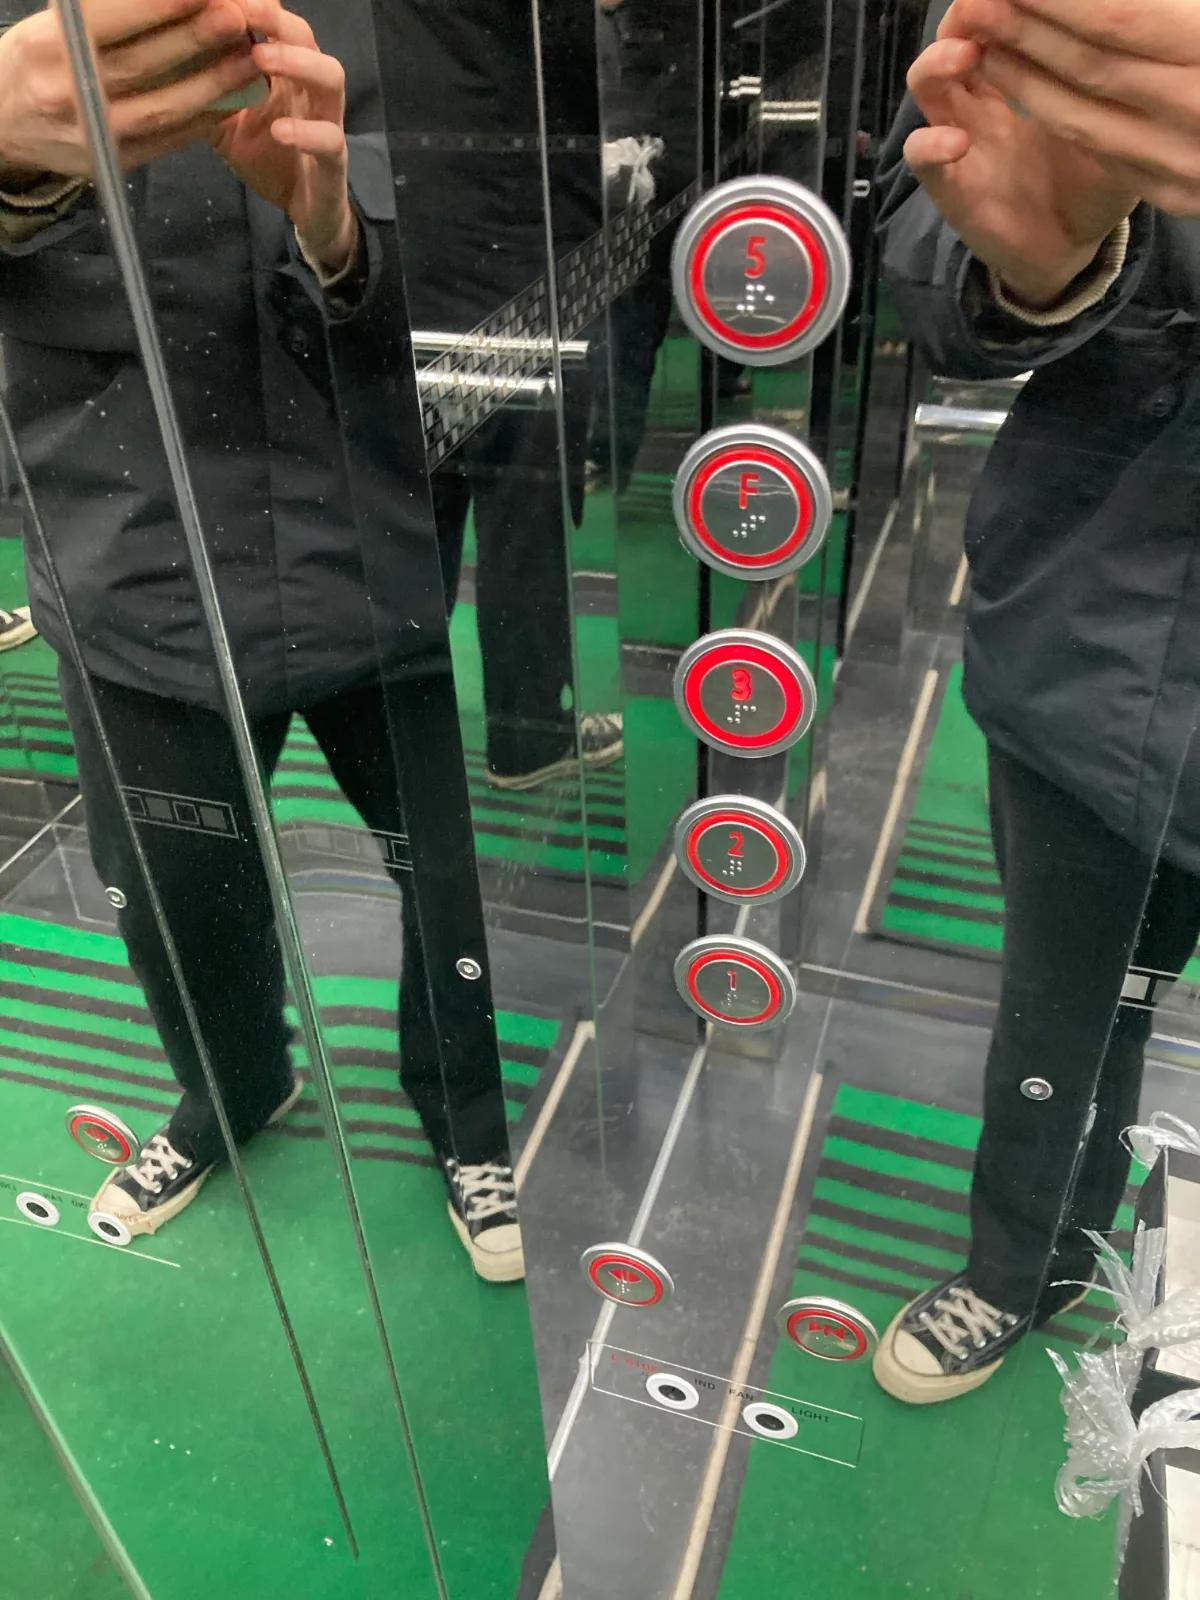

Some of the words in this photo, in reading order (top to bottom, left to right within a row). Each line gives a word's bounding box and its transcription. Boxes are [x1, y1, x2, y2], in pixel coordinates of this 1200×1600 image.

[744, 236, 766, 279] 5
[739, 472, 760, 510] F
[731, 668, 752, 701] 3
[728, 832, 744, 857] 2
[727, 970, 737, 991] 1
[694, 1378, 716, 1391] IND
[729, 1388, 754, 1402] FAN
[791, 1406, 830, 1423] LIGHT
